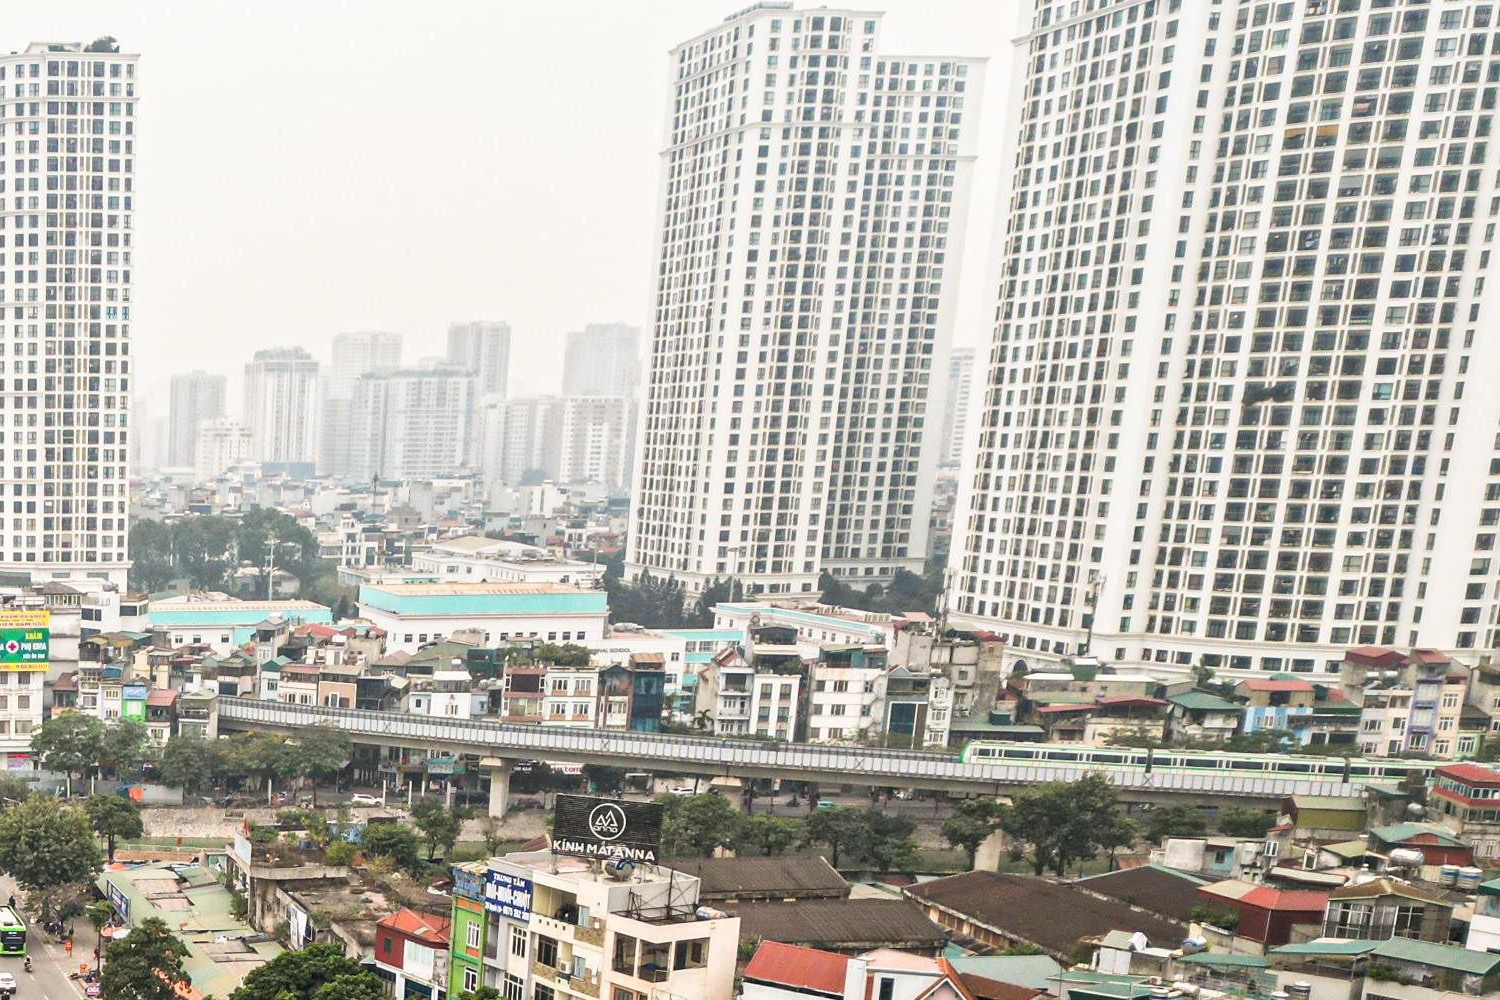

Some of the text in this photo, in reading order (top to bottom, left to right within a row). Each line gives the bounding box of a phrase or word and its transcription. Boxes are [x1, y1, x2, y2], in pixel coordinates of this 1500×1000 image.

[553, 839, 585, 852] KÍNH
[612, 847, 655, 861] ANNA
[493, 873, 512, 886] TRUNG
